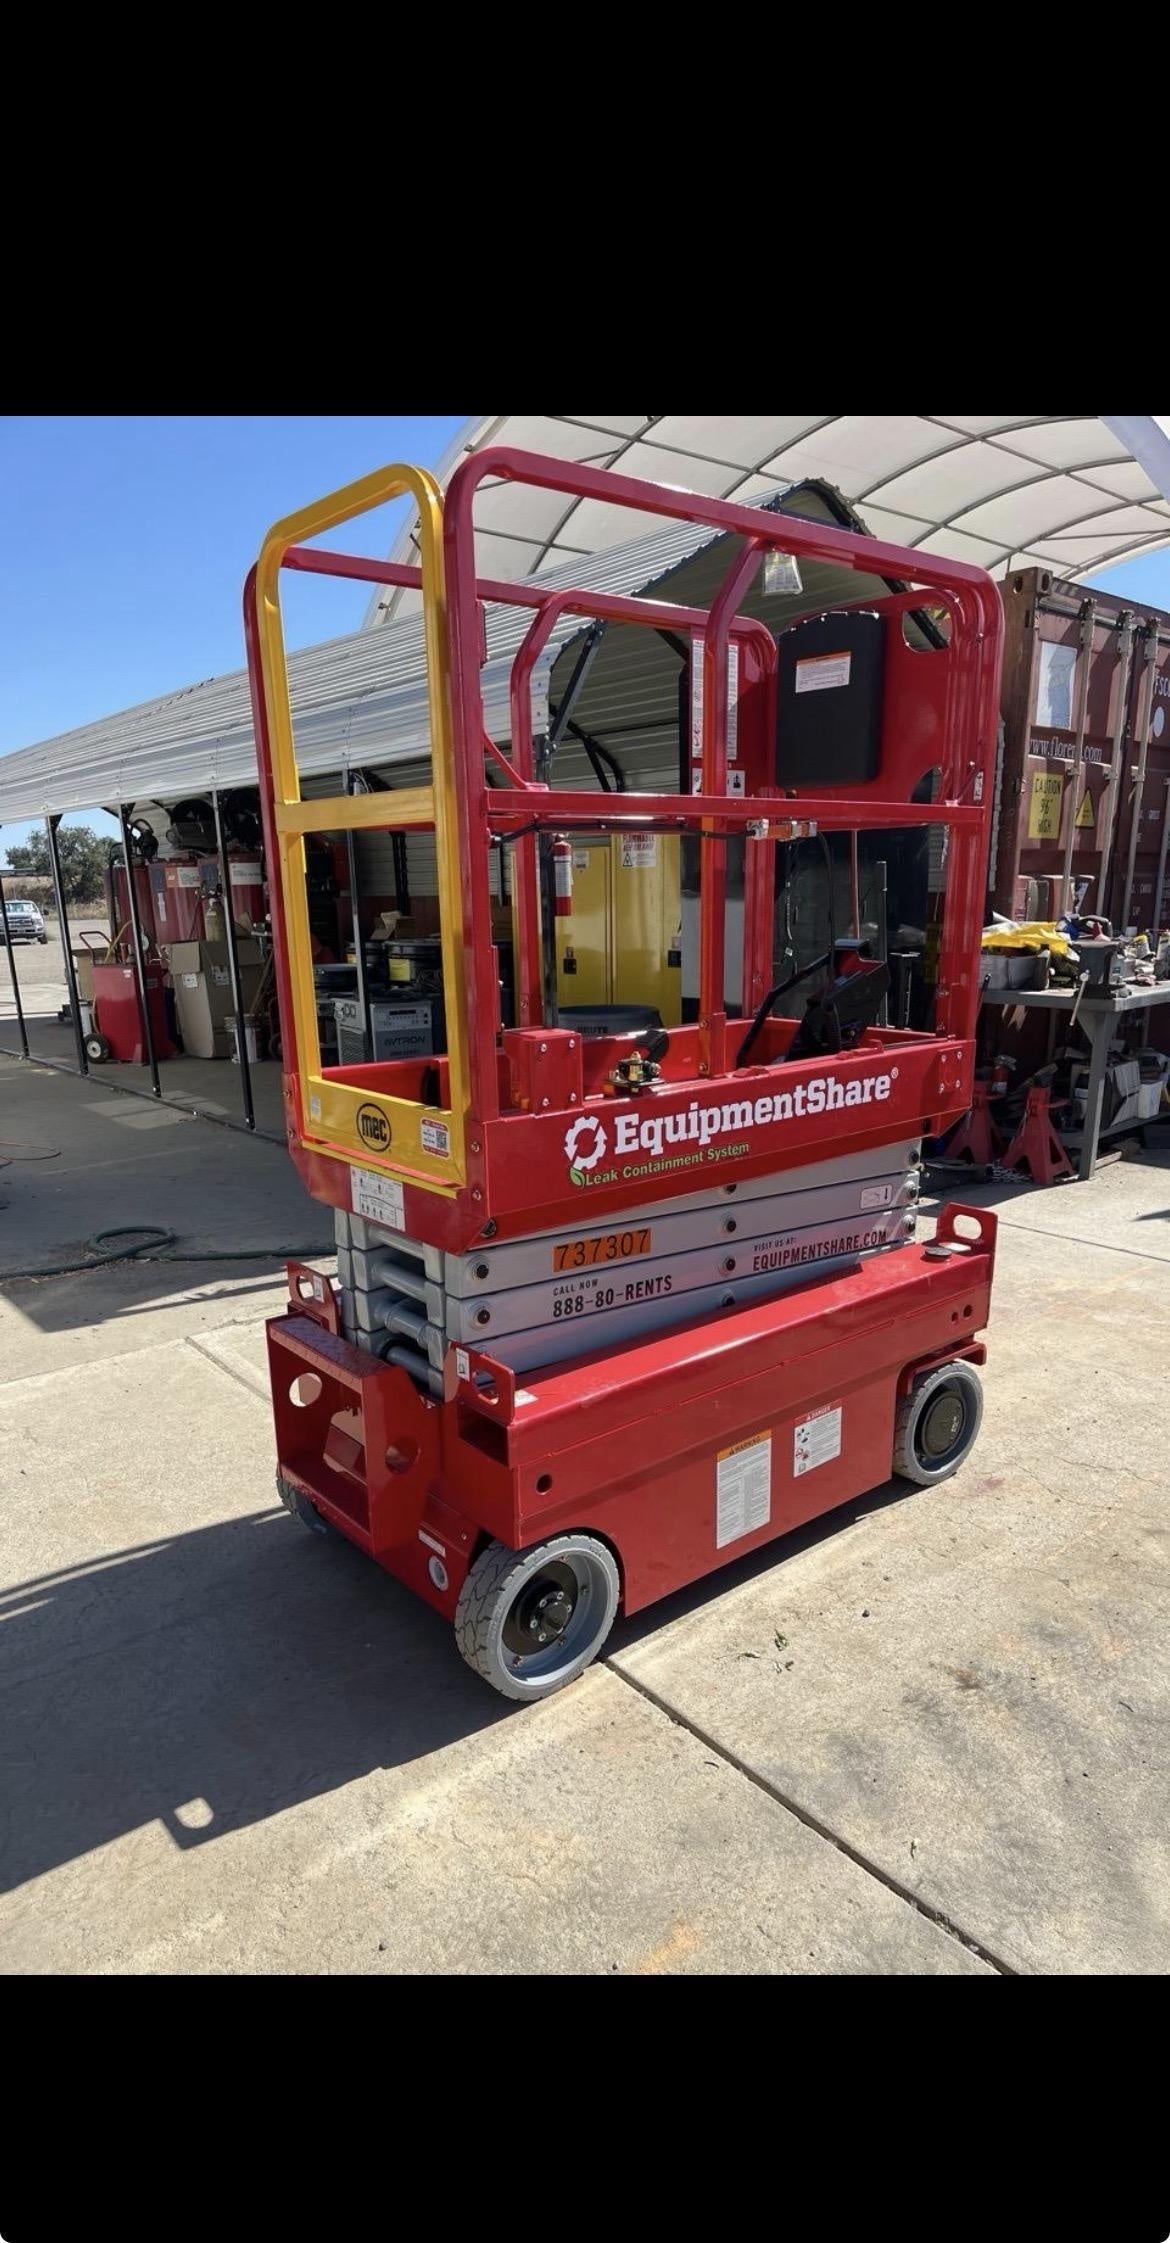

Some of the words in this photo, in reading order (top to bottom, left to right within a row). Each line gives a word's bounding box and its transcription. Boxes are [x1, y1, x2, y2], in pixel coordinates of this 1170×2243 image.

[585, 1168, 618, 1186] Leak
[623, 1150, 703, 1179] Containment
[707, 1142, 749, 1162] System
[557, 1229, 649, 1270] 737307
[753, 1240, 773, 1252] VISIT
[774, 1238, 784, 1248] US
[753, 1230, 887, 1271] EQUIPMENTSHARE.COM
[553, 1283, 575, 1297] CALL
[580, 1278, 599, 1291] NOW
[553, 1274, 672, 1318] 888-80-RENTS
